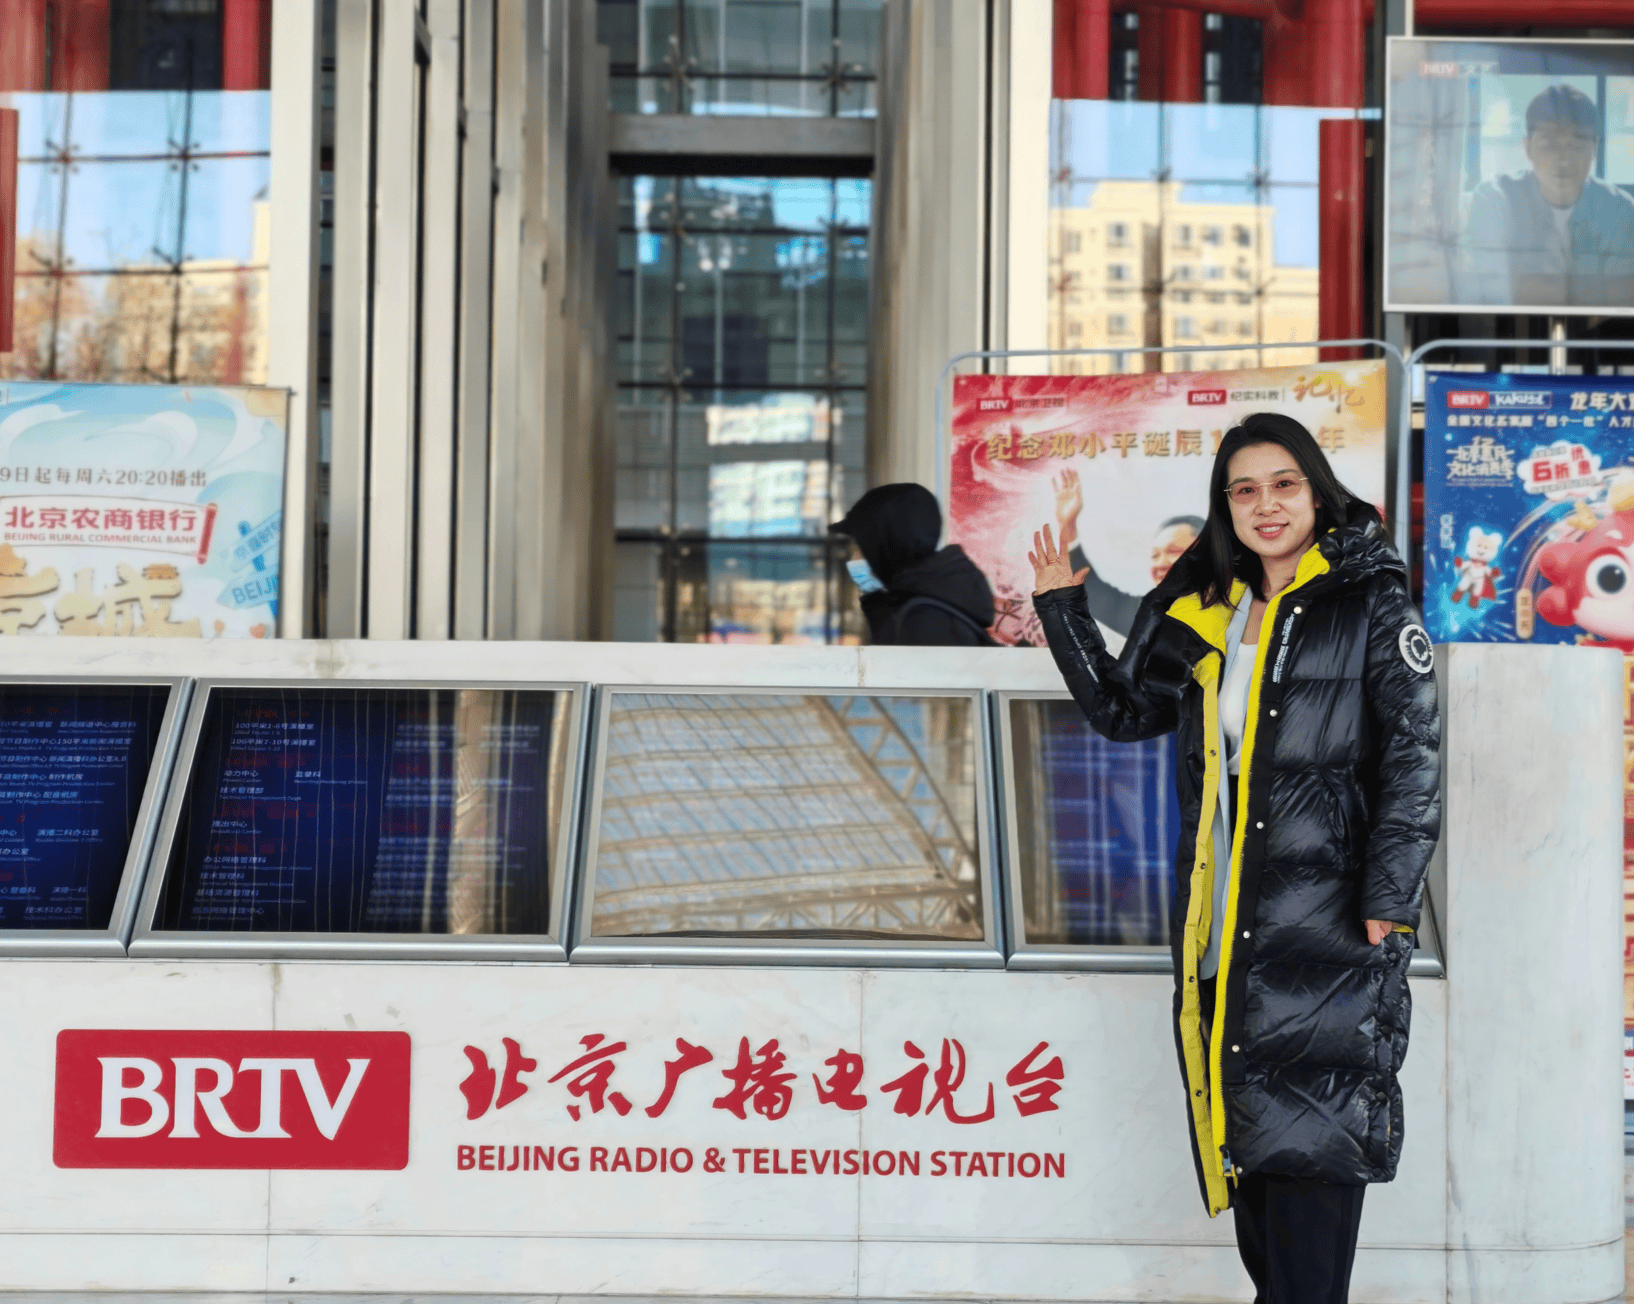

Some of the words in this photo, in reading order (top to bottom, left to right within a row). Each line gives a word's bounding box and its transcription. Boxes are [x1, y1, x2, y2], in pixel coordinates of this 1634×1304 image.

[1191, 392, 1223, 404] BRTV
[1230, 390, 1280, 402] 纪实科教
[1293, 375, 1365, 413] 记忆
[1450, 392, 1486, 406] BRTV
[980, 400, 1010, 411] BRTV
[5, 506, 197, 532] 北京农商银行
[4, 532, 46, 543] BEIJING
[49, 533, 86, 543] RURAL
[88, 534, 163, 545] COMMERCIAL
[166, 535, 196, 545] BANK
[458, 1033, 1066, 1124] 北京广播电视台
[95, 1057, 371, 1141] BRTV
[457, 1145, 580, 1172] BEIJING
[589, 1146, 694, 1173] RADIO
[703, 1147, 726, 1173] &
[732, 1148, 921, 1176] TELEVISION
[930, 1150, 1066, 1178] STATION
